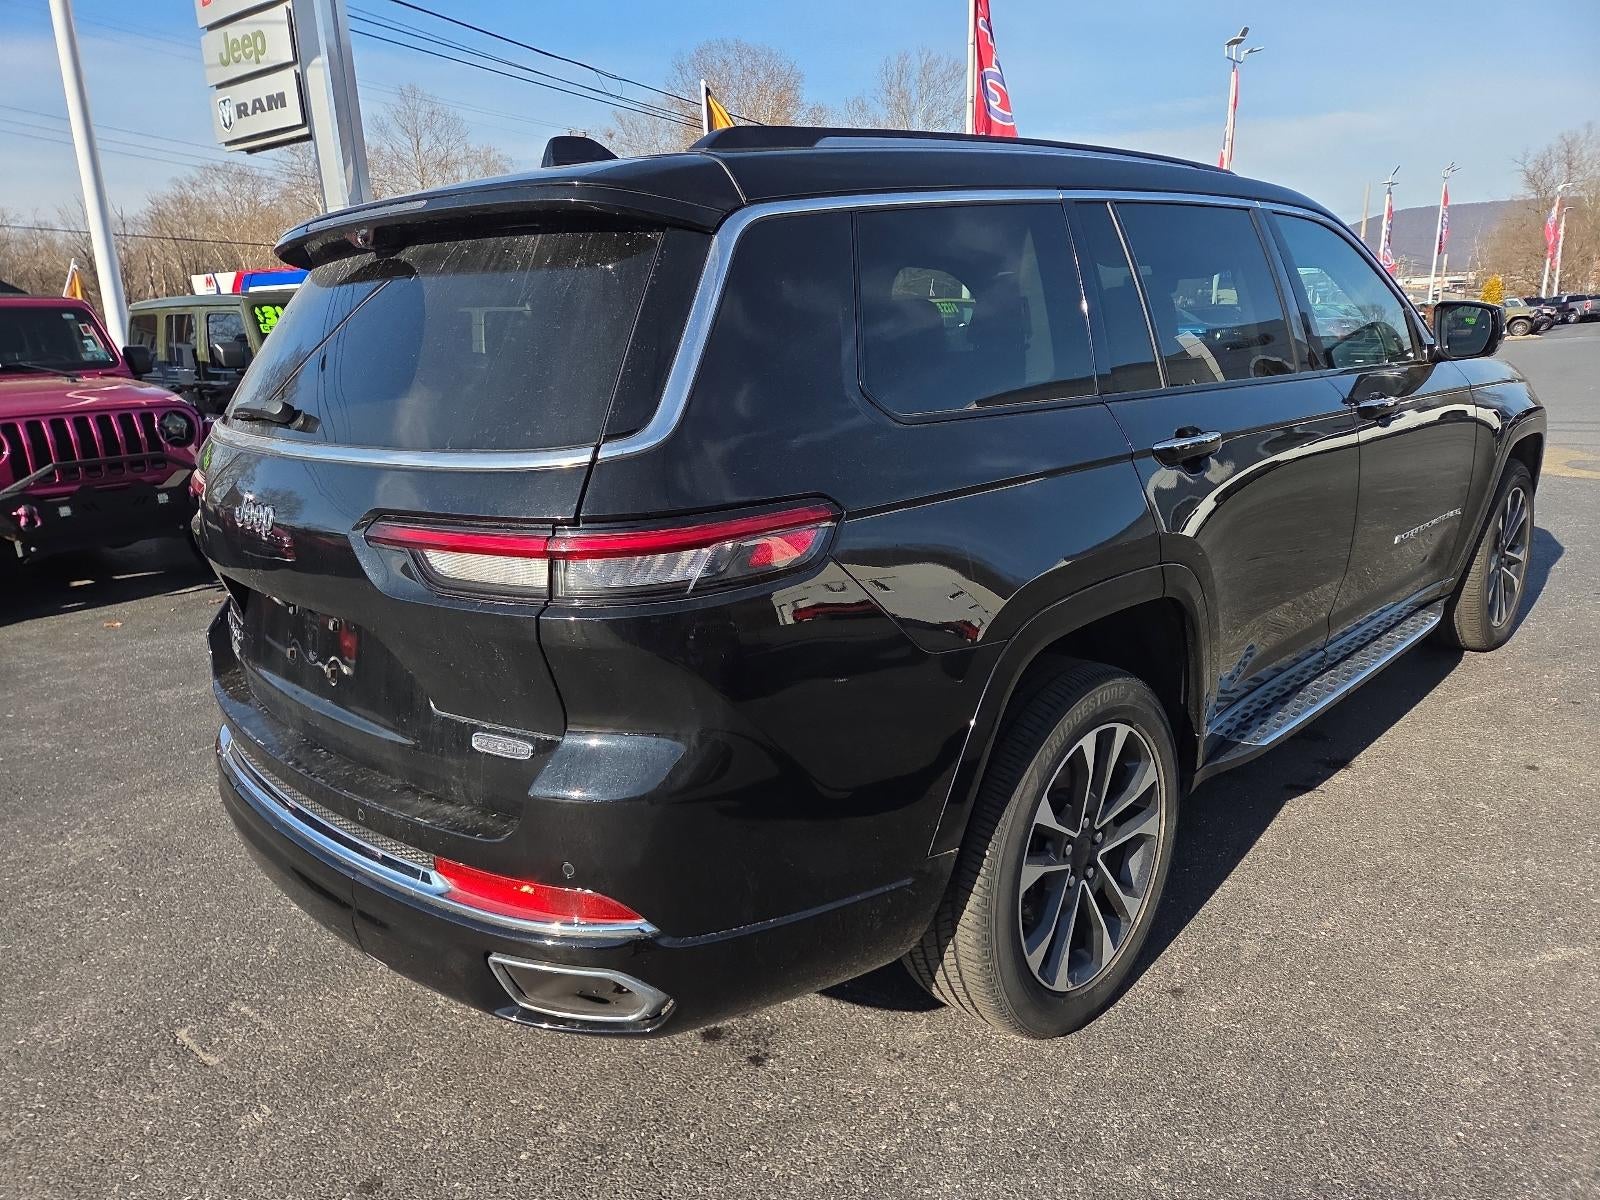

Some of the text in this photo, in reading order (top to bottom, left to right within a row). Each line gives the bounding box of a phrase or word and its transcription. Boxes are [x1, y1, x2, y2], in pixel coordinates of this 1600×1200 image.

[219, 29, 267, 67] Jeep
[236, 91, 287, 119] RAM
[235, 491, 275, 537] Jeep
